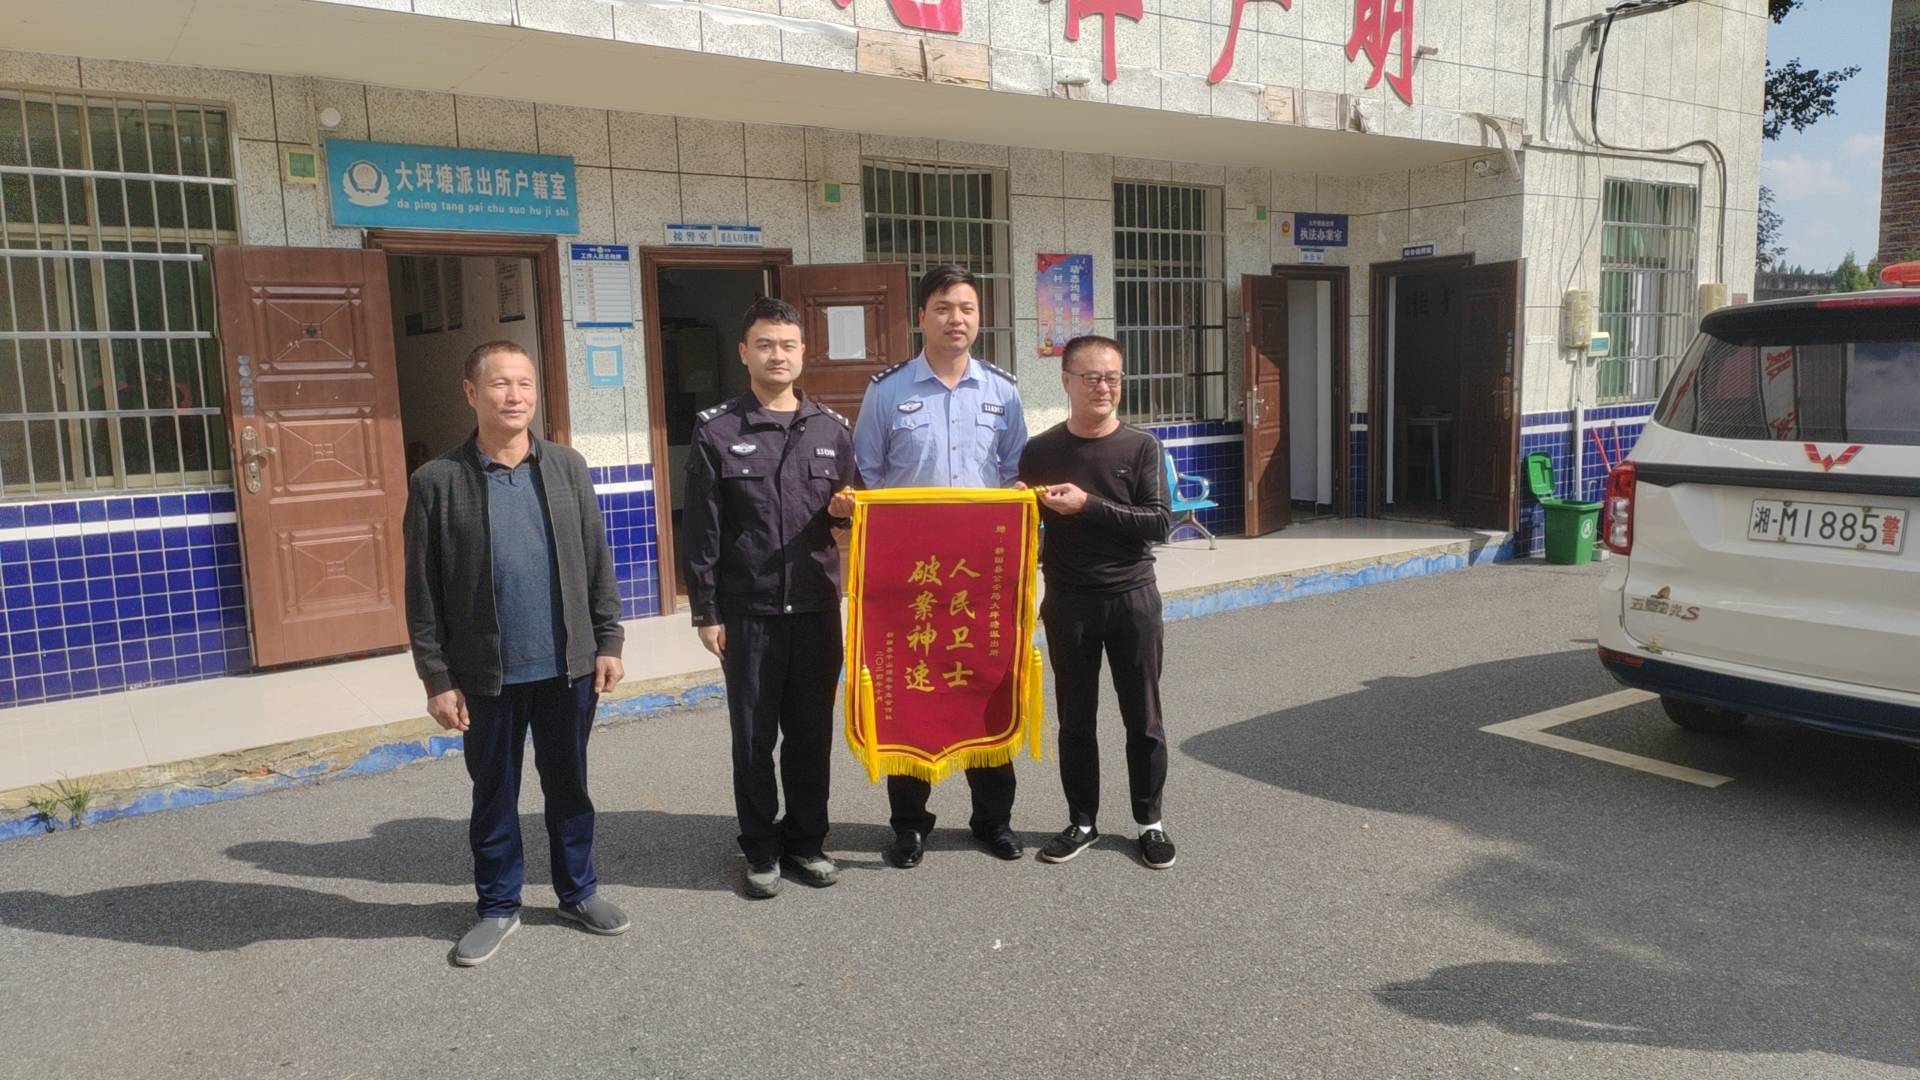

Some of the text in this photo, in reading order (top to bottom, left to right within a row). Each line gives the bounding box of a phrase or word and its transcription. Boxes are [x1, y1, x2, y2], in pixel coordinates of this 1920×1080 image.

[395, 161, 567, 200] 大坪塘派出所户籍室
[397, 199, 569, 217] da ping tang pai chu suo hu ji shi
[904, 555, 942, 692] 破案神速
[942, 558, 981, 688] 人民卫士
